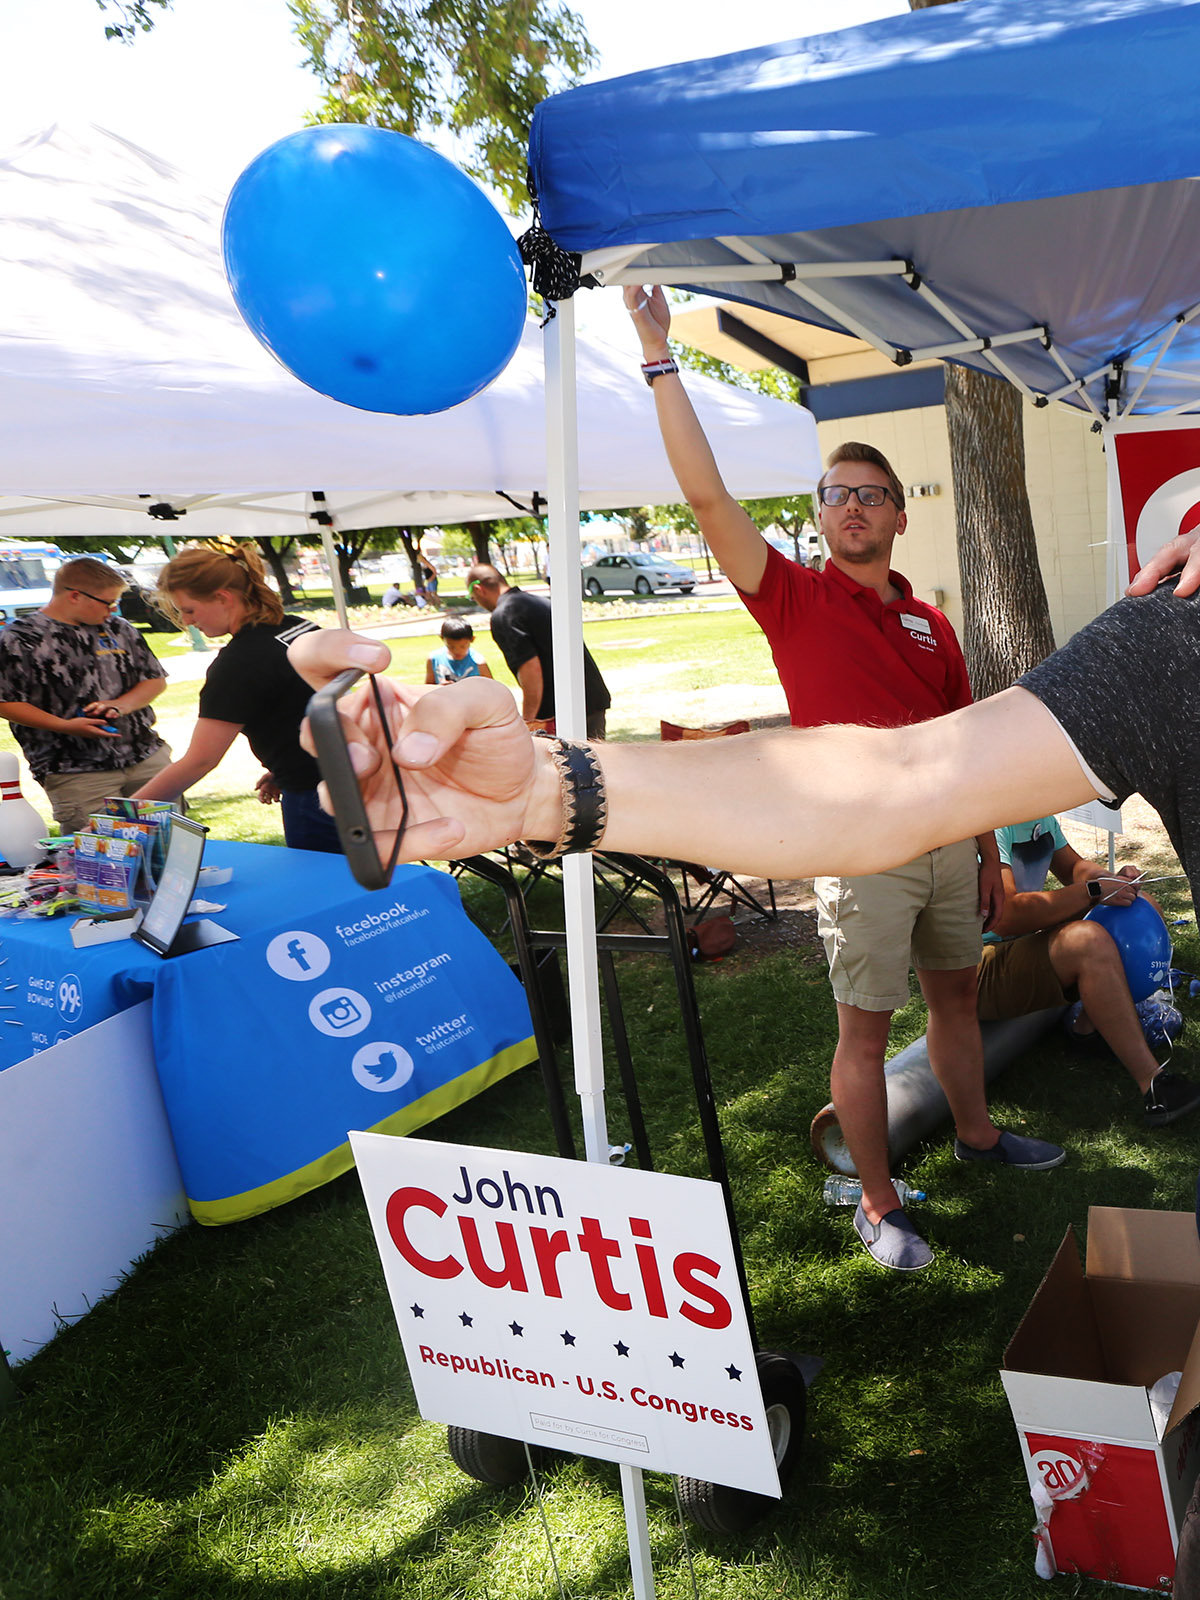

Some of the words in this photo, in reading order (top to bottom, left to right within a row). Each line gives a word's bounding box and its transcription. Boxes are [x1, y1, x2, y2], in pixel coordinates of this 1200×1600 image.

[910, 631, 937, 646] Curtis
[335, 902, 409, 939] facebook
[344, 908, 430, 947] facebook/fatcatsfun
[44, 980, 55, 991] OF
[374, 952, 452, 993] instagram
[384, 974, 437, 1004] @fatcatsfun
[415, 1013, 467, 1047] twitter
[425, 1025, 474, 1055] @fatcatsfun
[452, 1166, 564, 1218] John
[385, 1186, 733, 1330] Curtis
[418, 1344, 555, 1389] Republican
[576, 1374, 624, 1403] U.S.
[630, 1386, 754, 1432] Congress
[552, 1421, 563, 1430] for
[575, 1426, 598, 1437] Curtis
[598, 1431, 609, 1440] for
[610, 1434, 646, 1448] Congress
